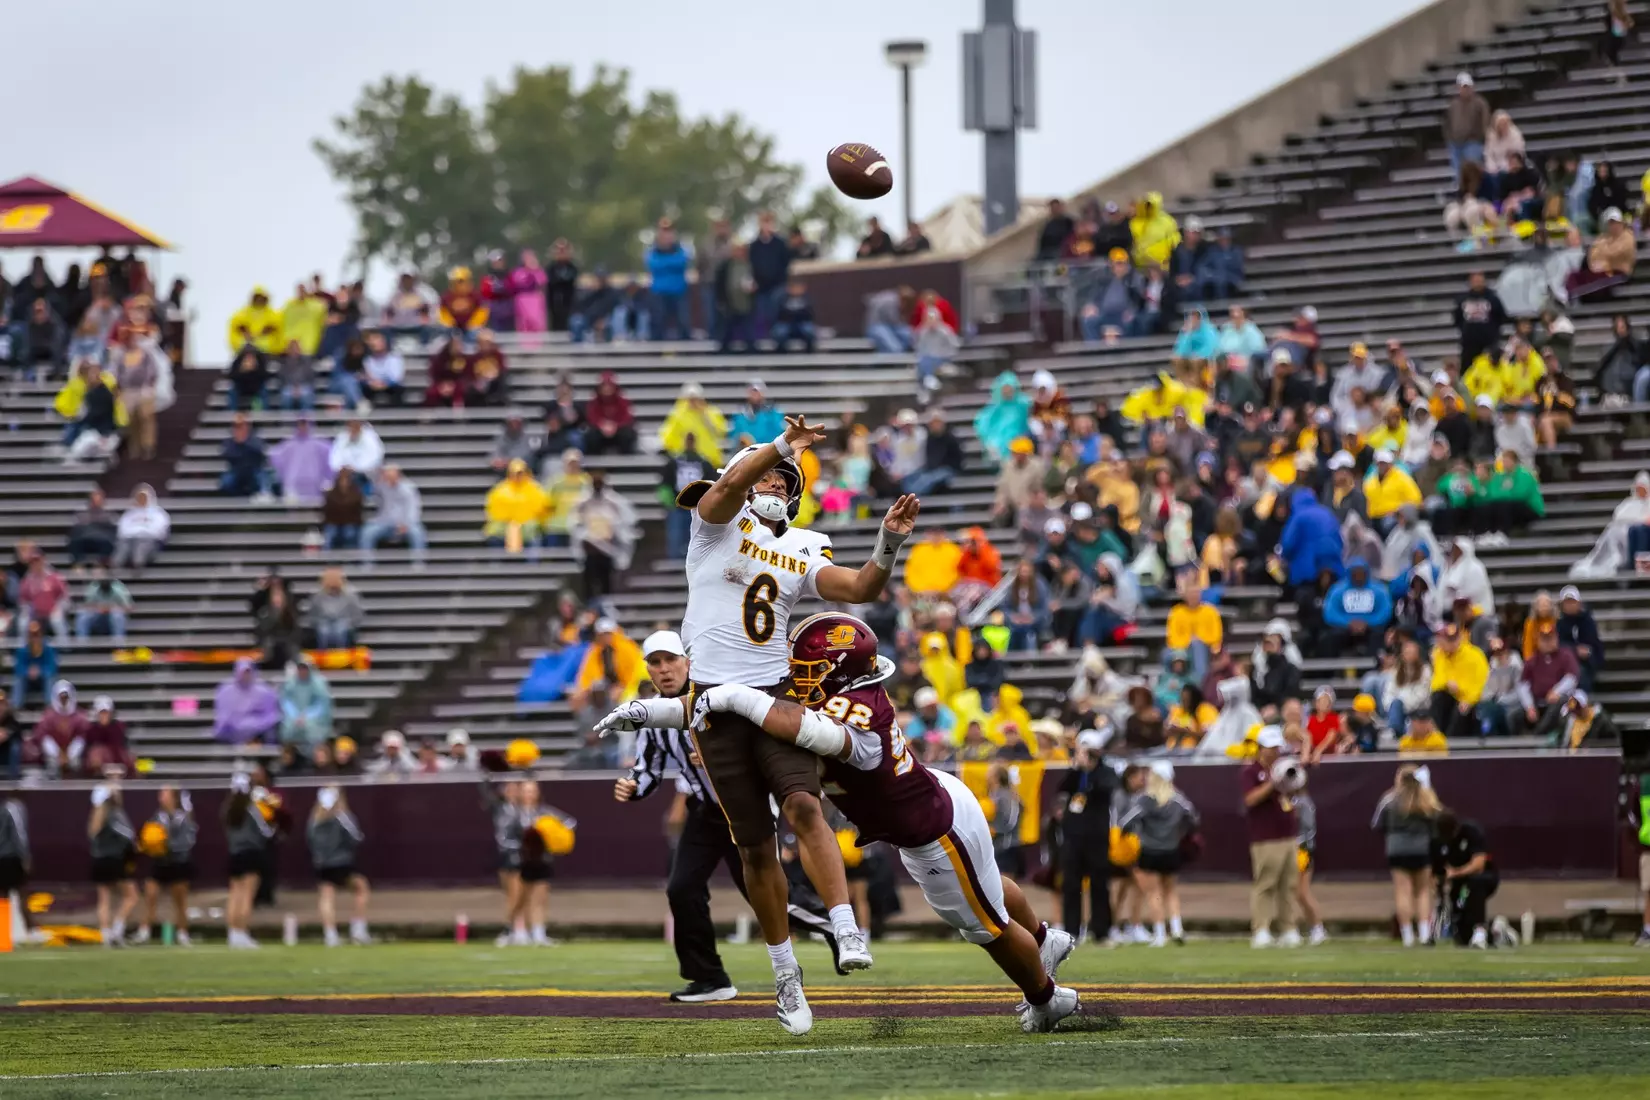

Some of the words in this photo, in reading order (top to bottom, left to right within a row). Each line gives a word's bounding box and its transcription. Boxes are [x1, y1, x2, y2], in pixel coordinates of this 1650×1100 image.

[738, 538, 807, 577] WYOMING
[742, 572, 779, 646] 6
[825, 696, 873, 731] 92
